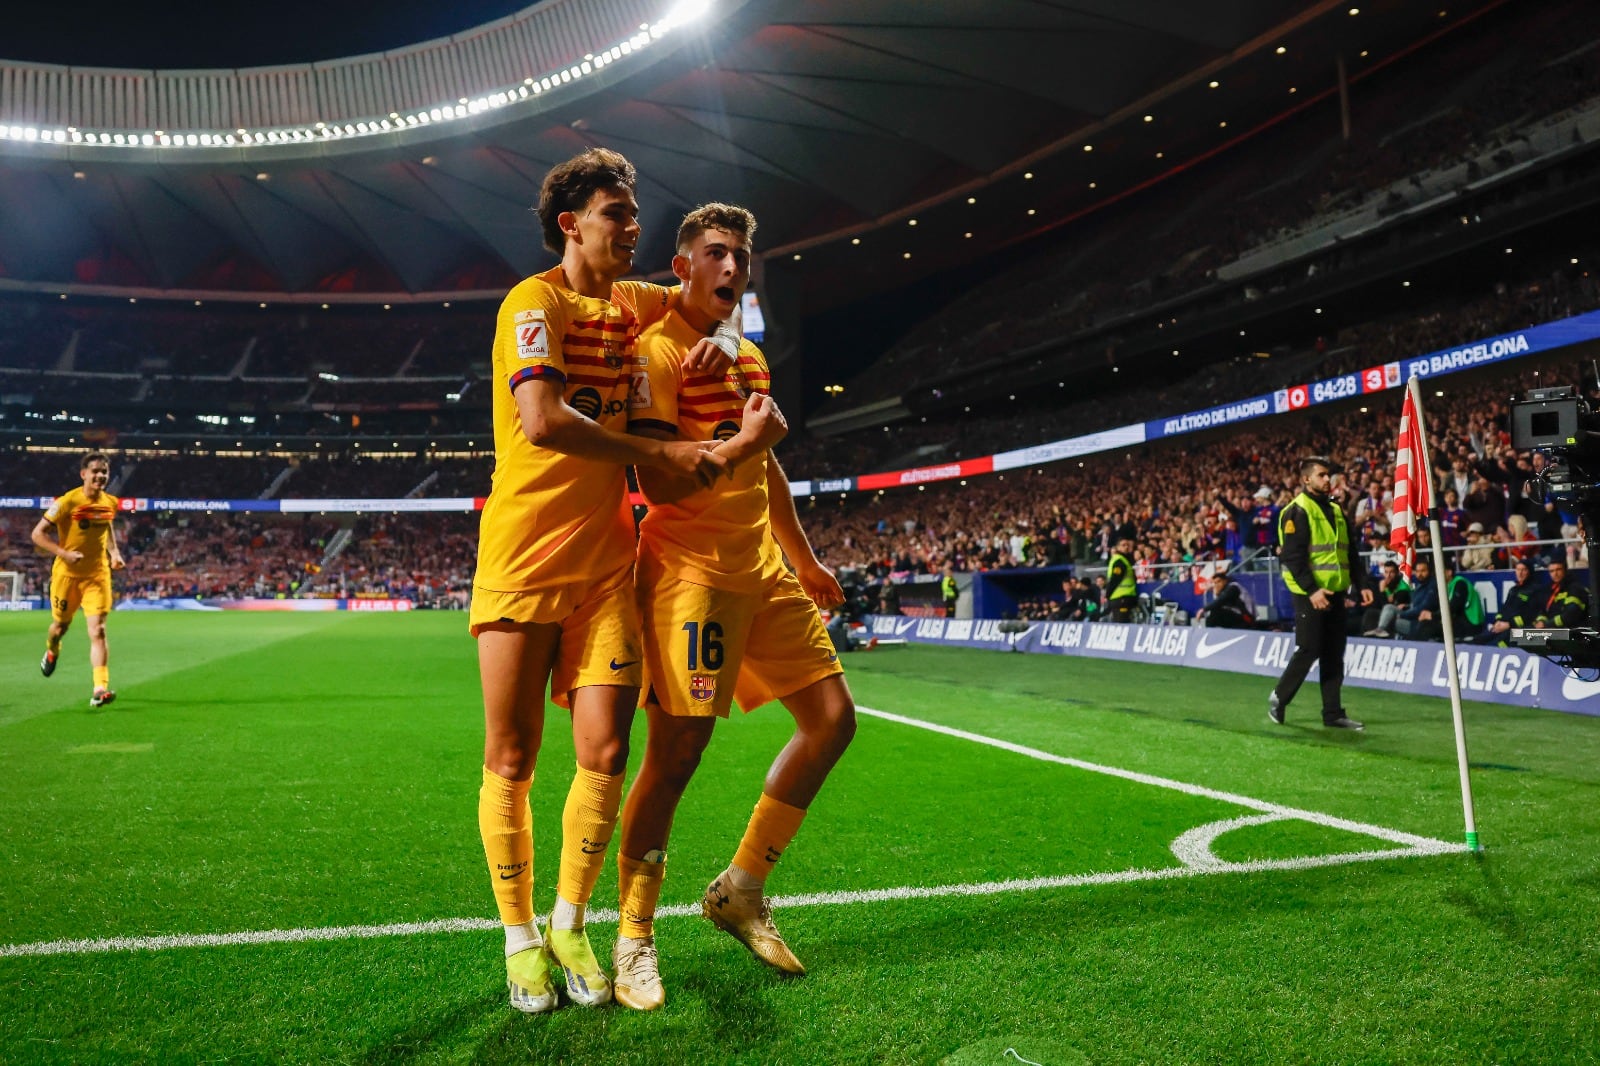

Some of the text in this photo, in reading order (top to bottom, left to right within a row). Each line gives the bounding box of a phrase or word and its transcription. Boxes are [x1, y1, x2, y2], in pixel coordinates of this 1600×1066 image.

[1164, 335, 1529, 434] ATLÉTICO DE MADRID 0 64:28 3 FC BARCELONA
[0, 499, 34, 508] ADRID
[169, 500, 231, 510] BARCELONA
[53, 596, 67, 611] 39
[681, 621, 724, 670] 16
[1040, 623, 1189, 656] LALIGA MARCA LALIGA
[1344, 643, 1418, 684] MARCA
[1431, 650, 1540, 696] LALIGA
